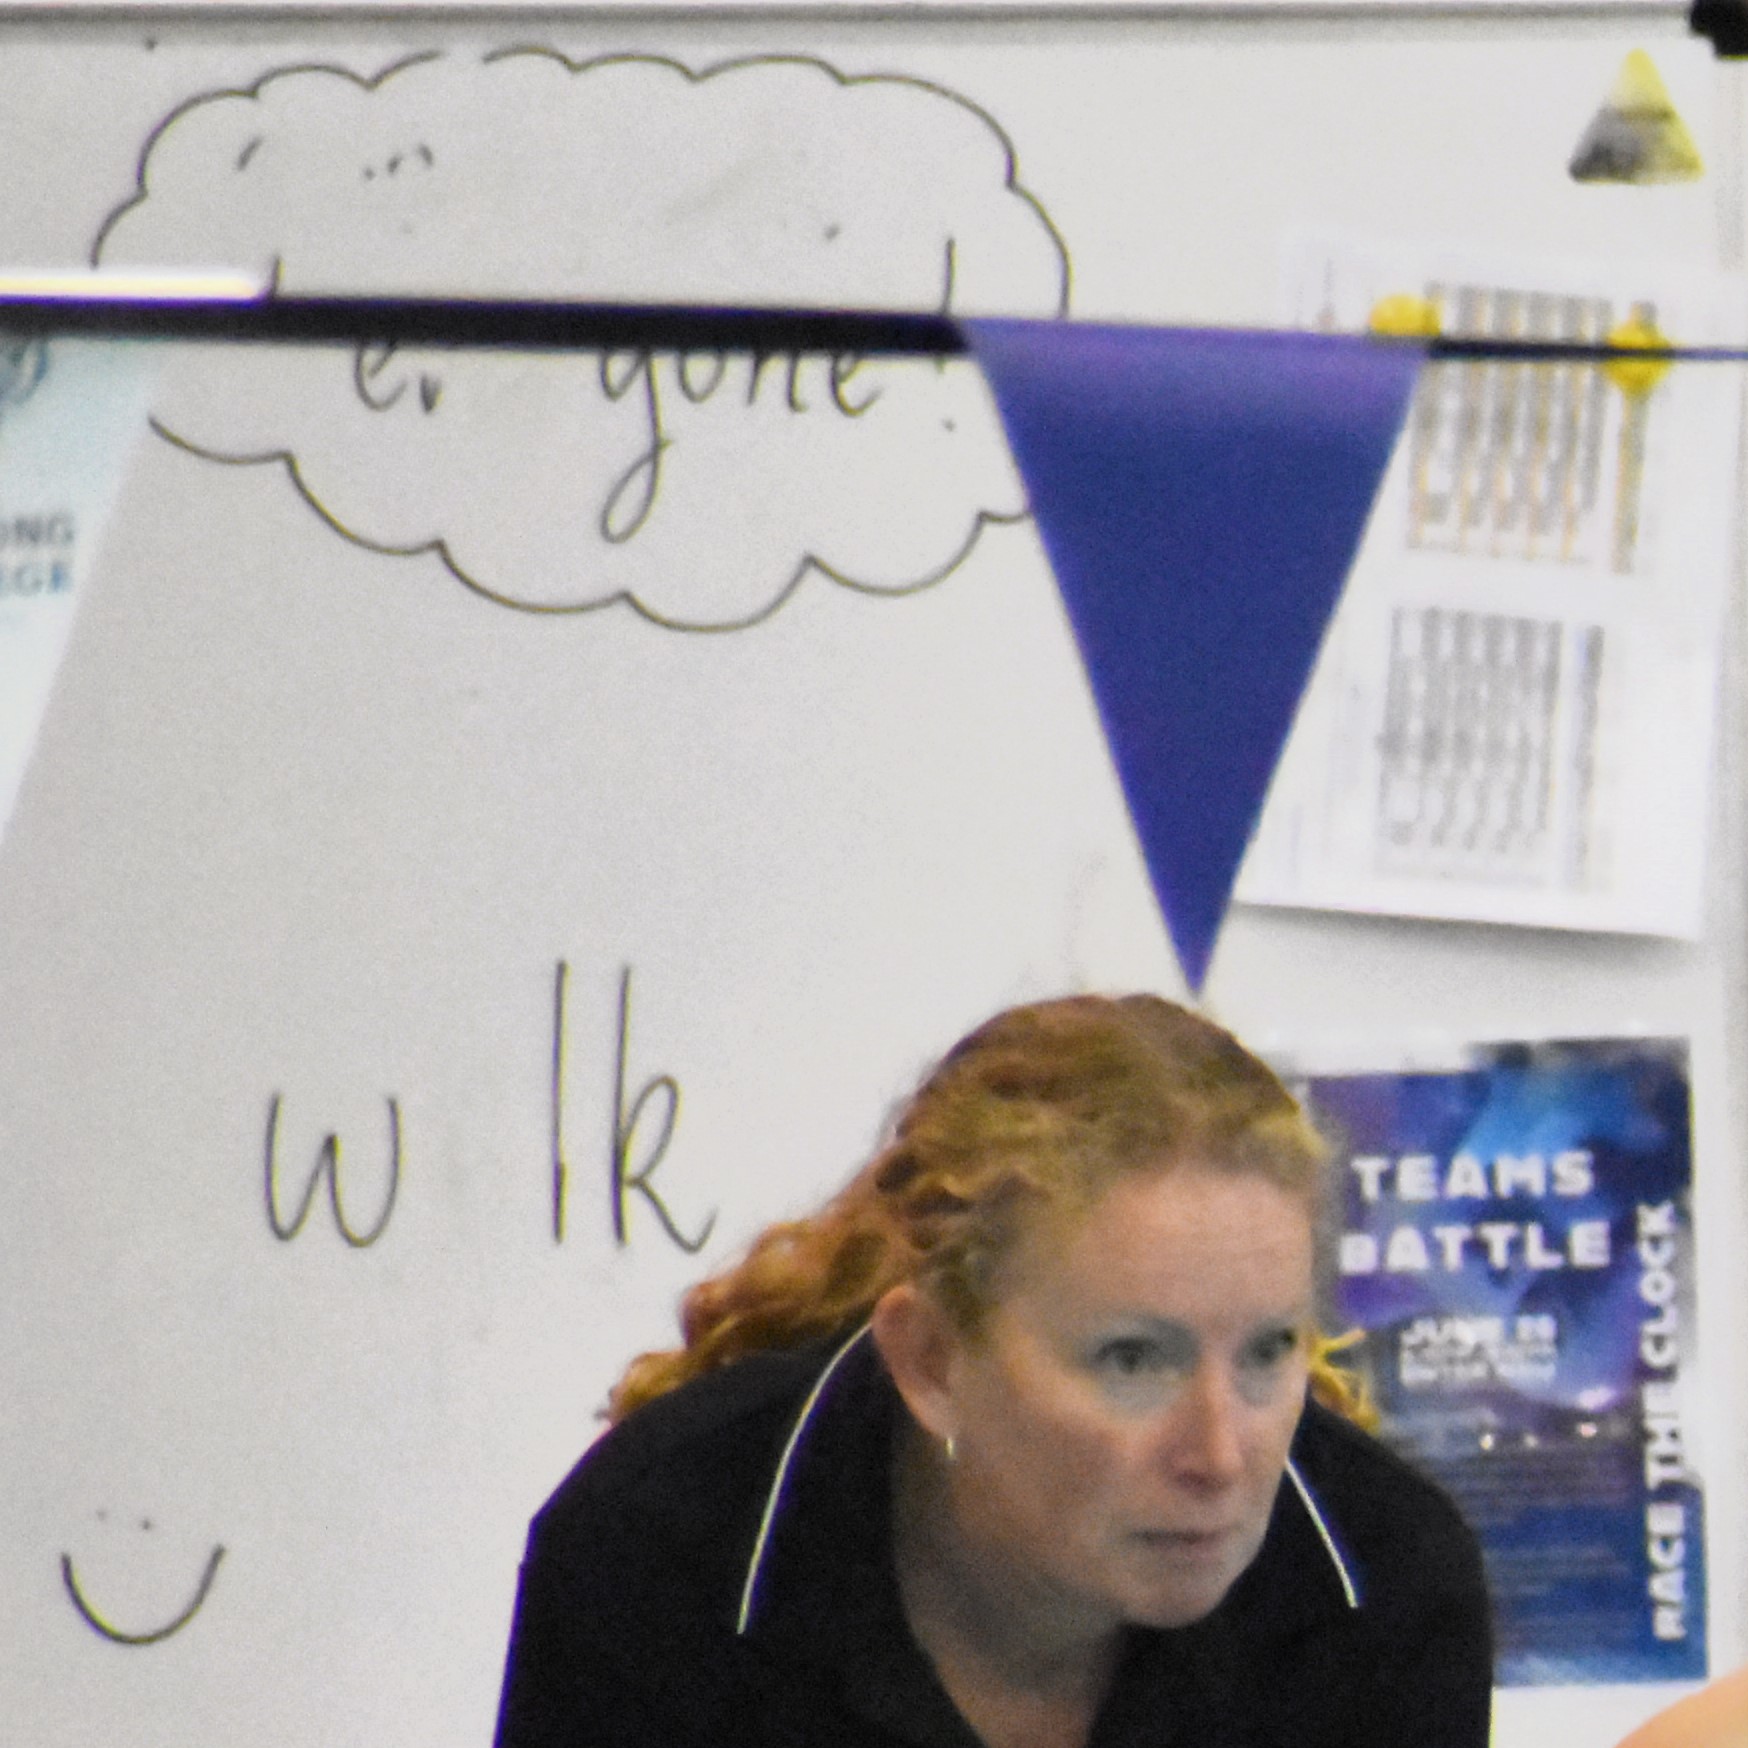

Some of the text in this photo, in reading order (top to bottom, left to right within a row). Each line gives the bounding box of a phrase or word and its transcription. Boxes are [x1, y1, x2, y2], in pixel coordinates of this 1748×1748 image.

[1350, 1149, 1597, 1202] TEAMS
[1338, 1220, 1612, 1276] BATTLE
[1635, 1200, 1681, 1370] CLOCK
[1646, 1500, 1688, 1642] RACE
